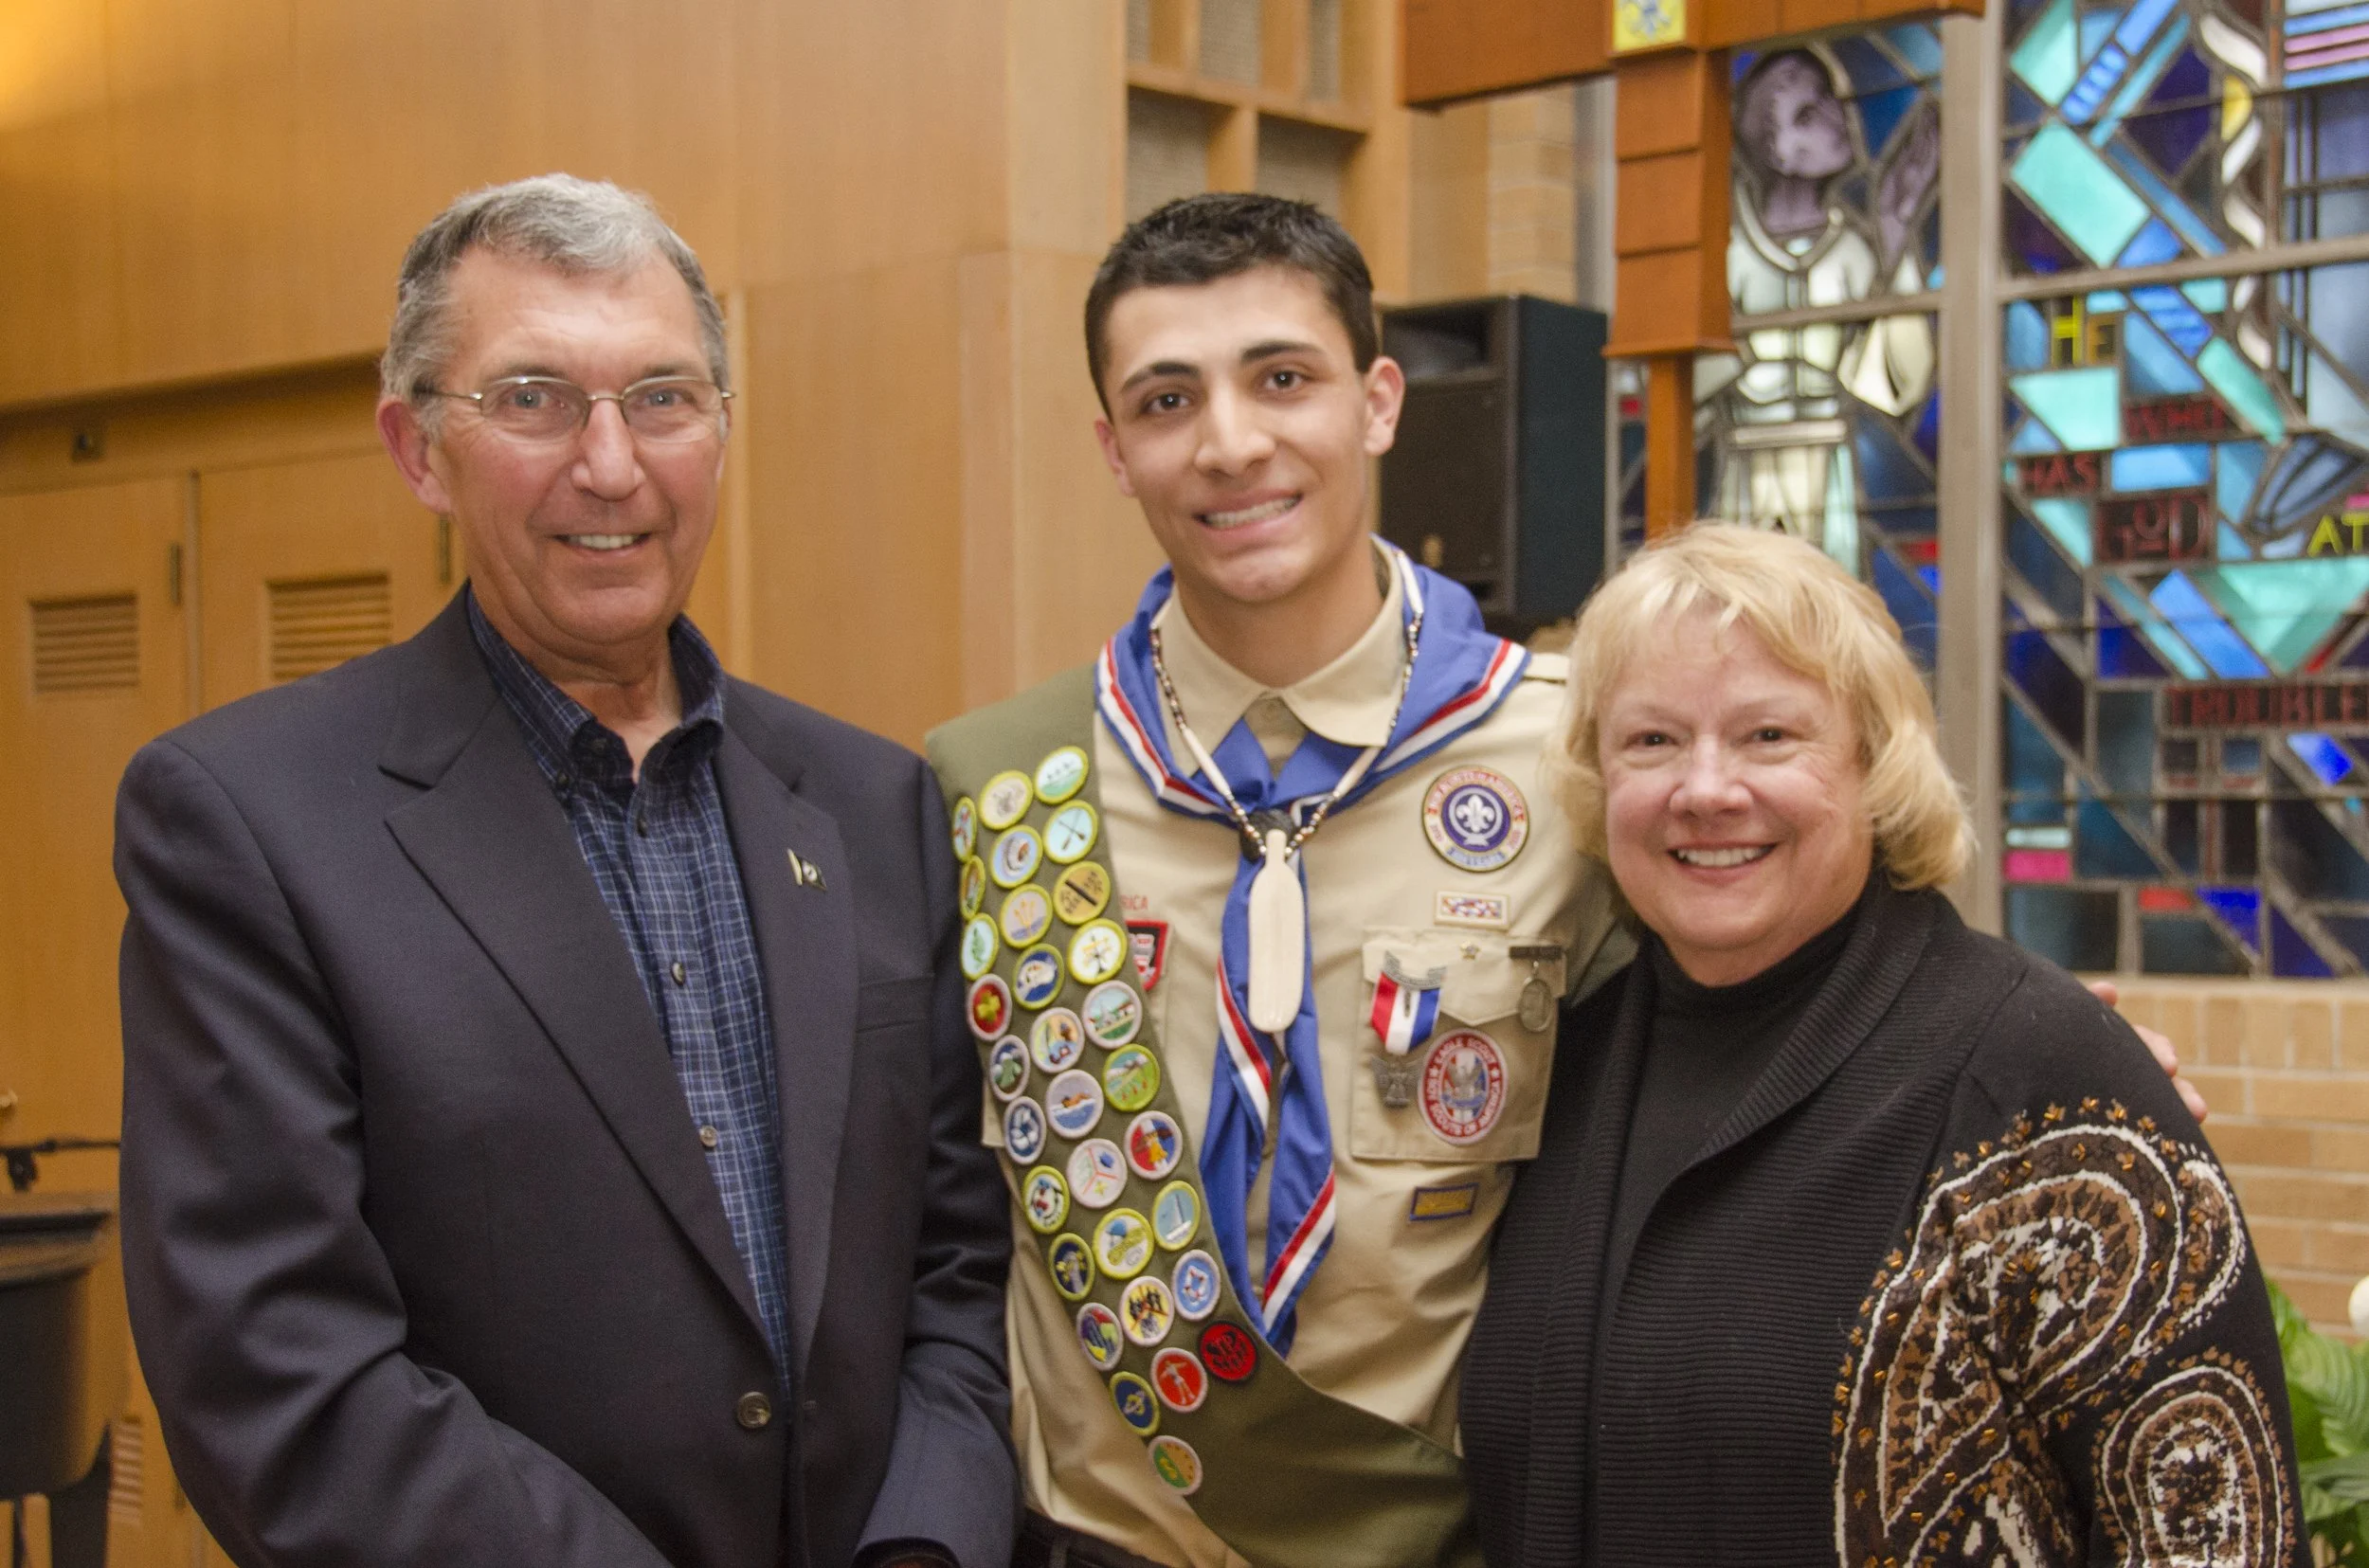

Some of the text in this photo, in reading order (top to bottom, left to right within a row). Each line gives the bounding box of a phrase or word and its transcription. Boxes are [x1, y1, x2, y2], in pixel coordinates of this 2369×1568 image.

[2053, 296, 2116, 365] HE
[2022, 453, 2097, 494] HAS
[2096, 494, 2211, 562] GOD
[2306, 514, 2369, 557] AT
[2162, 683, 2369, 727] TROUBLE
